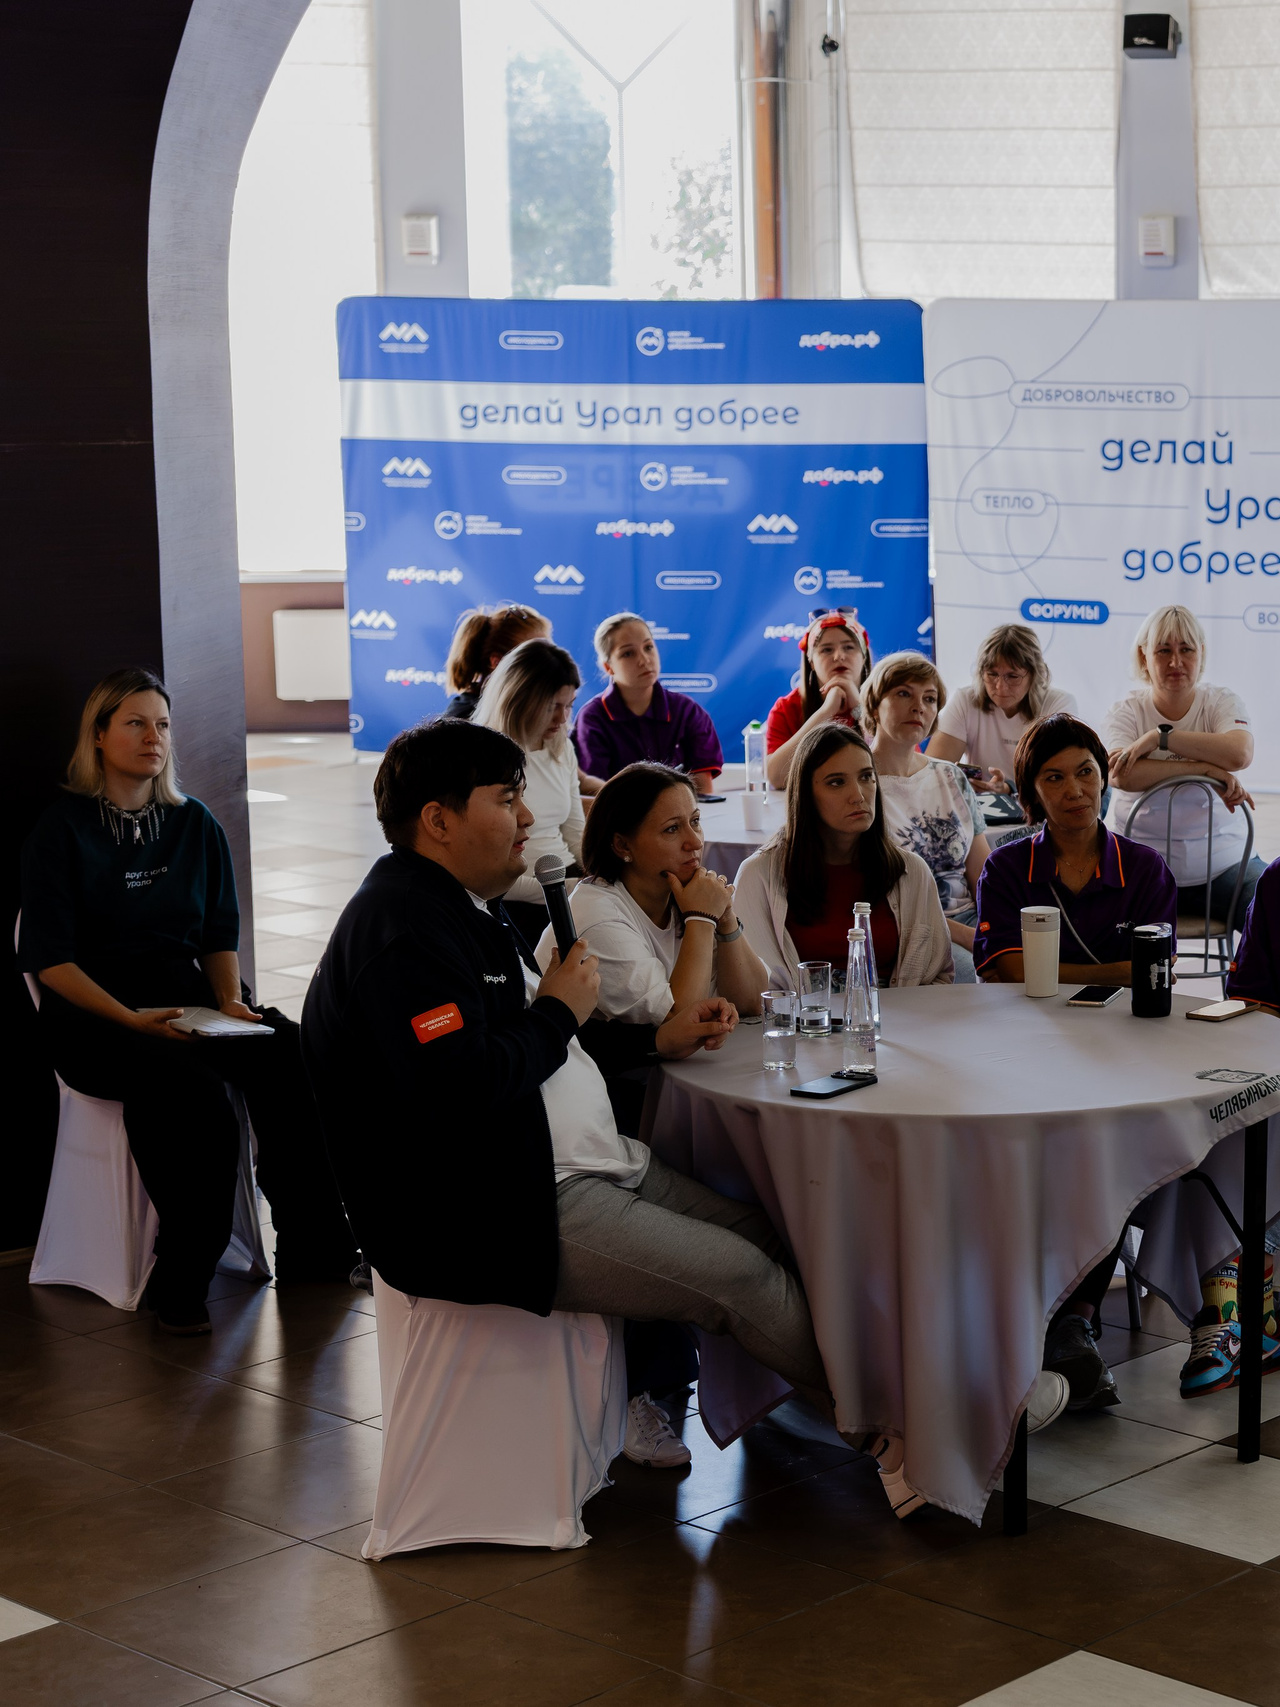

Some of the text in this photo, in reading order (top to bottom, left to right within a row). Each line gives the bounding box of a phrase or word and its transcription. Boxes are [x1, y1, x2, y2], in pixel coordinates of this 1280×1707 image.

[799, 331, 881, 349] добро.рф
[1021, 388, 1176, 404] ДОБРОВОЛЬЧЕСТВО
[459, 399, 800, 431] делай Урал добрее
[1101, 431, 1233, 471] делай
[803, 466, 885, 485] добро.рф
[983, 494, 1034, 510] ТЕПЛО
[596, 518, 675, 537] добро.рф
[386, 565, 464, 585] добро.рф
[1028, 602, 1101, 621] ФОРУМЫ
[385, 667, 446, 686] добро.р
[427, 1019, 451, 1031] ОБЛАСТЬ
